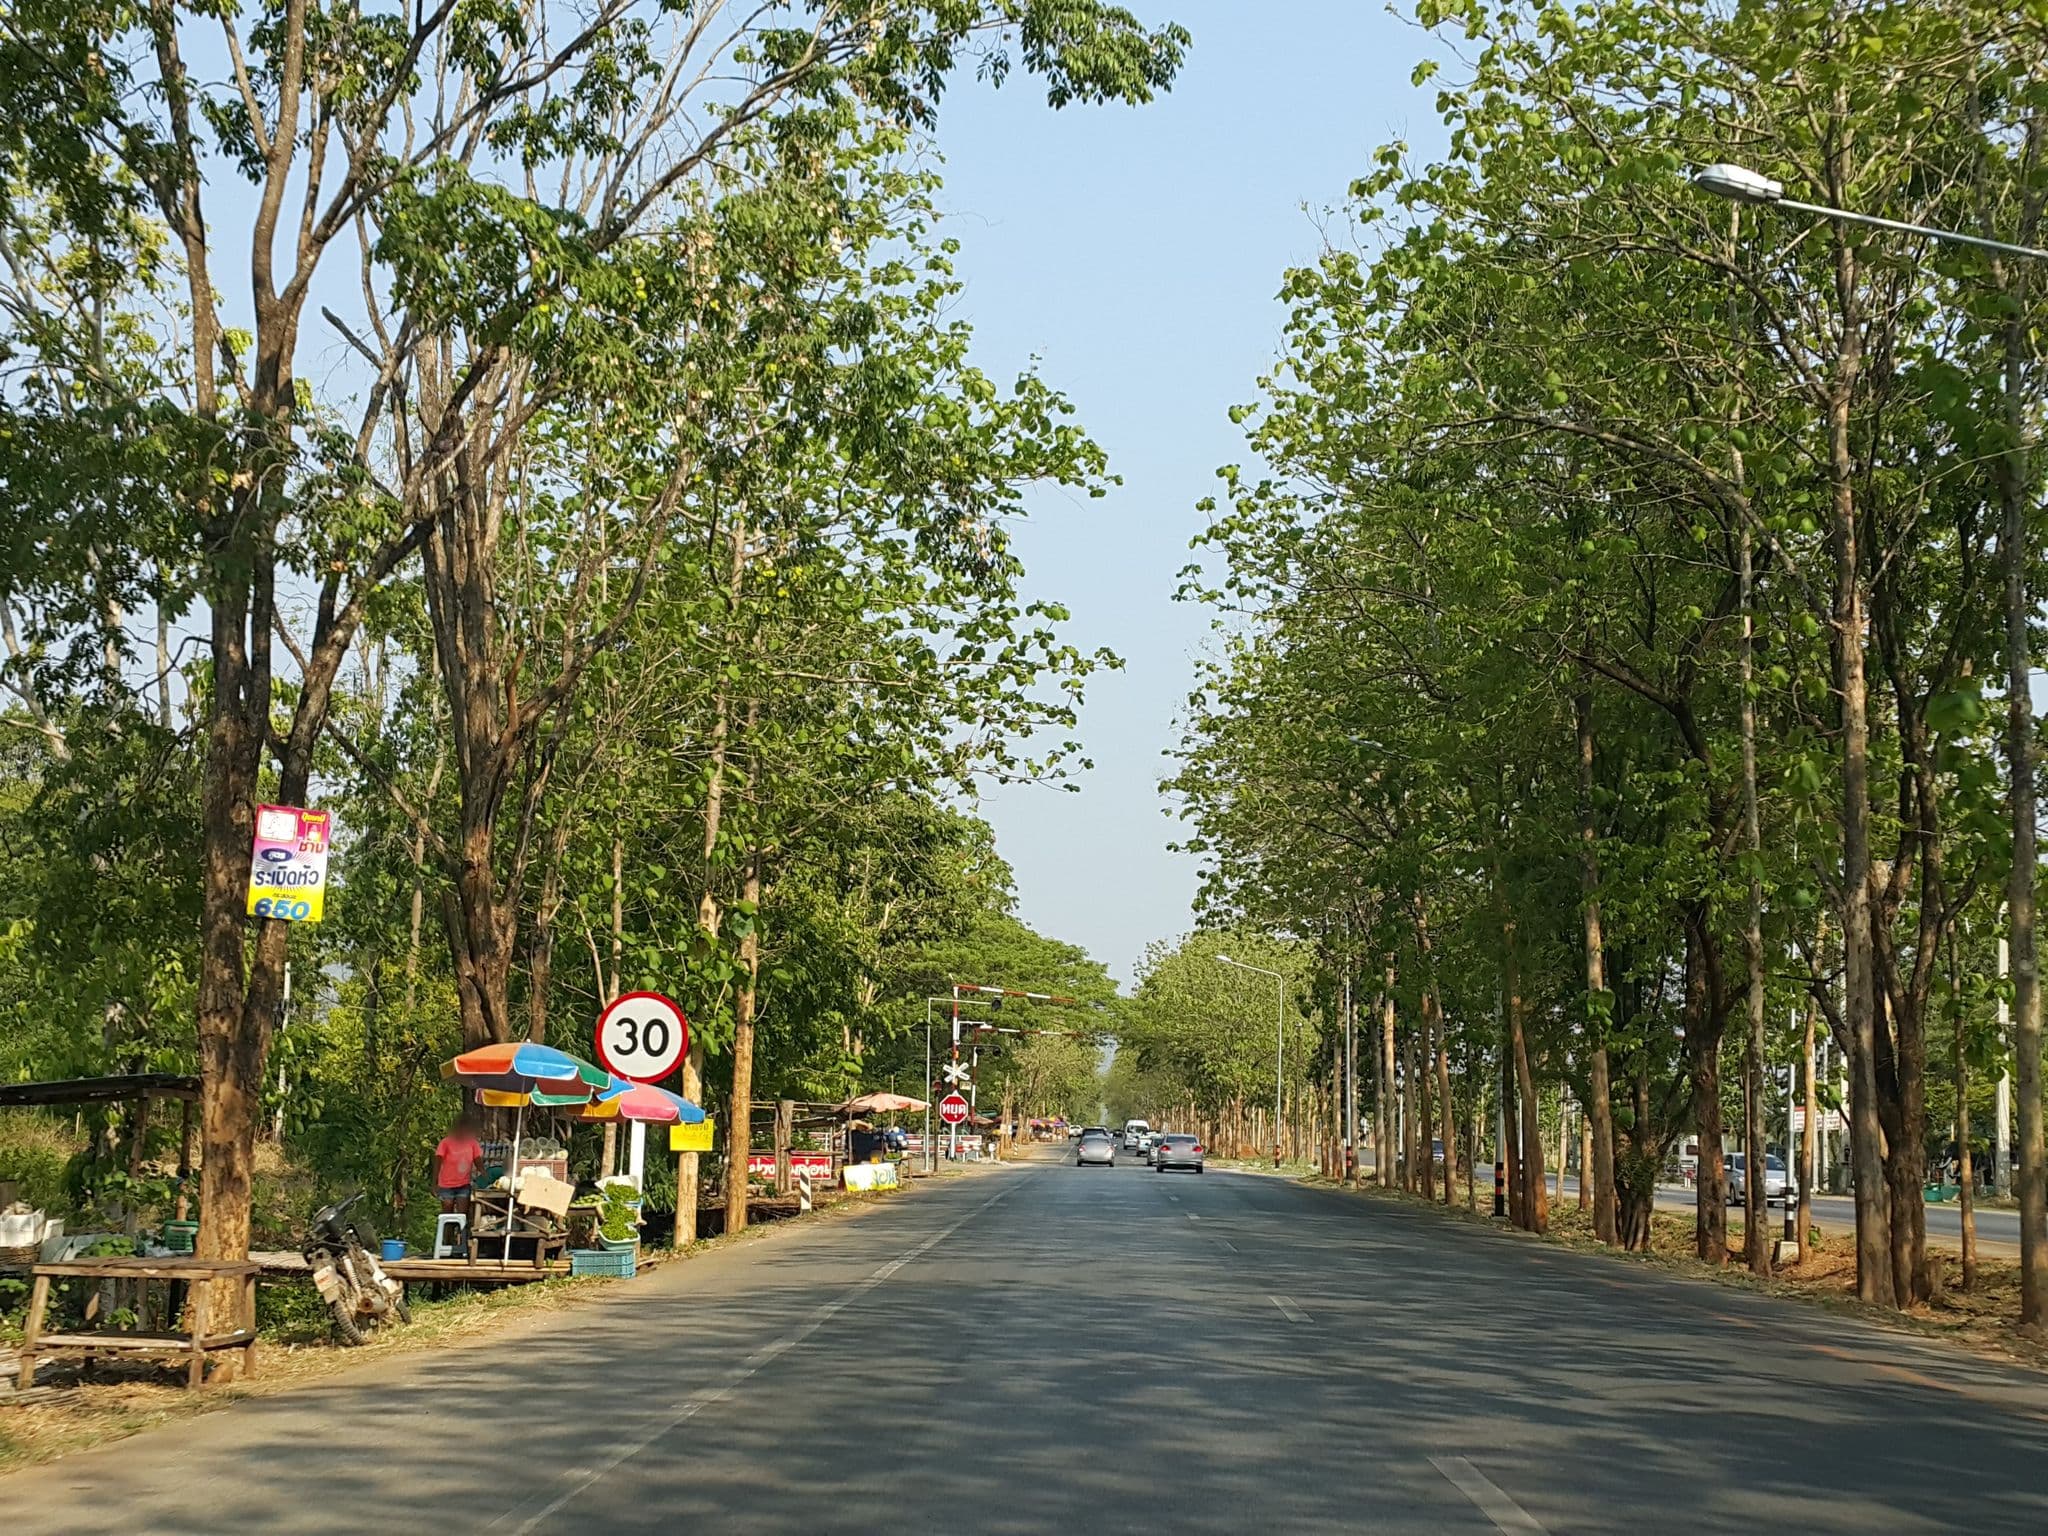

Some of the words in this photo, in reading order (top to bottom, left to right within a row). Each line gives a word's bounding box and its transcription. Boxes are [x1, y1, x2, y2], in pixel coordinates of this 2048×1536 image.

[254, 898, 310, 920] 650
[613, 1017, 669, 1057] 30
[942, 1104, 966, 1119] หยุด
